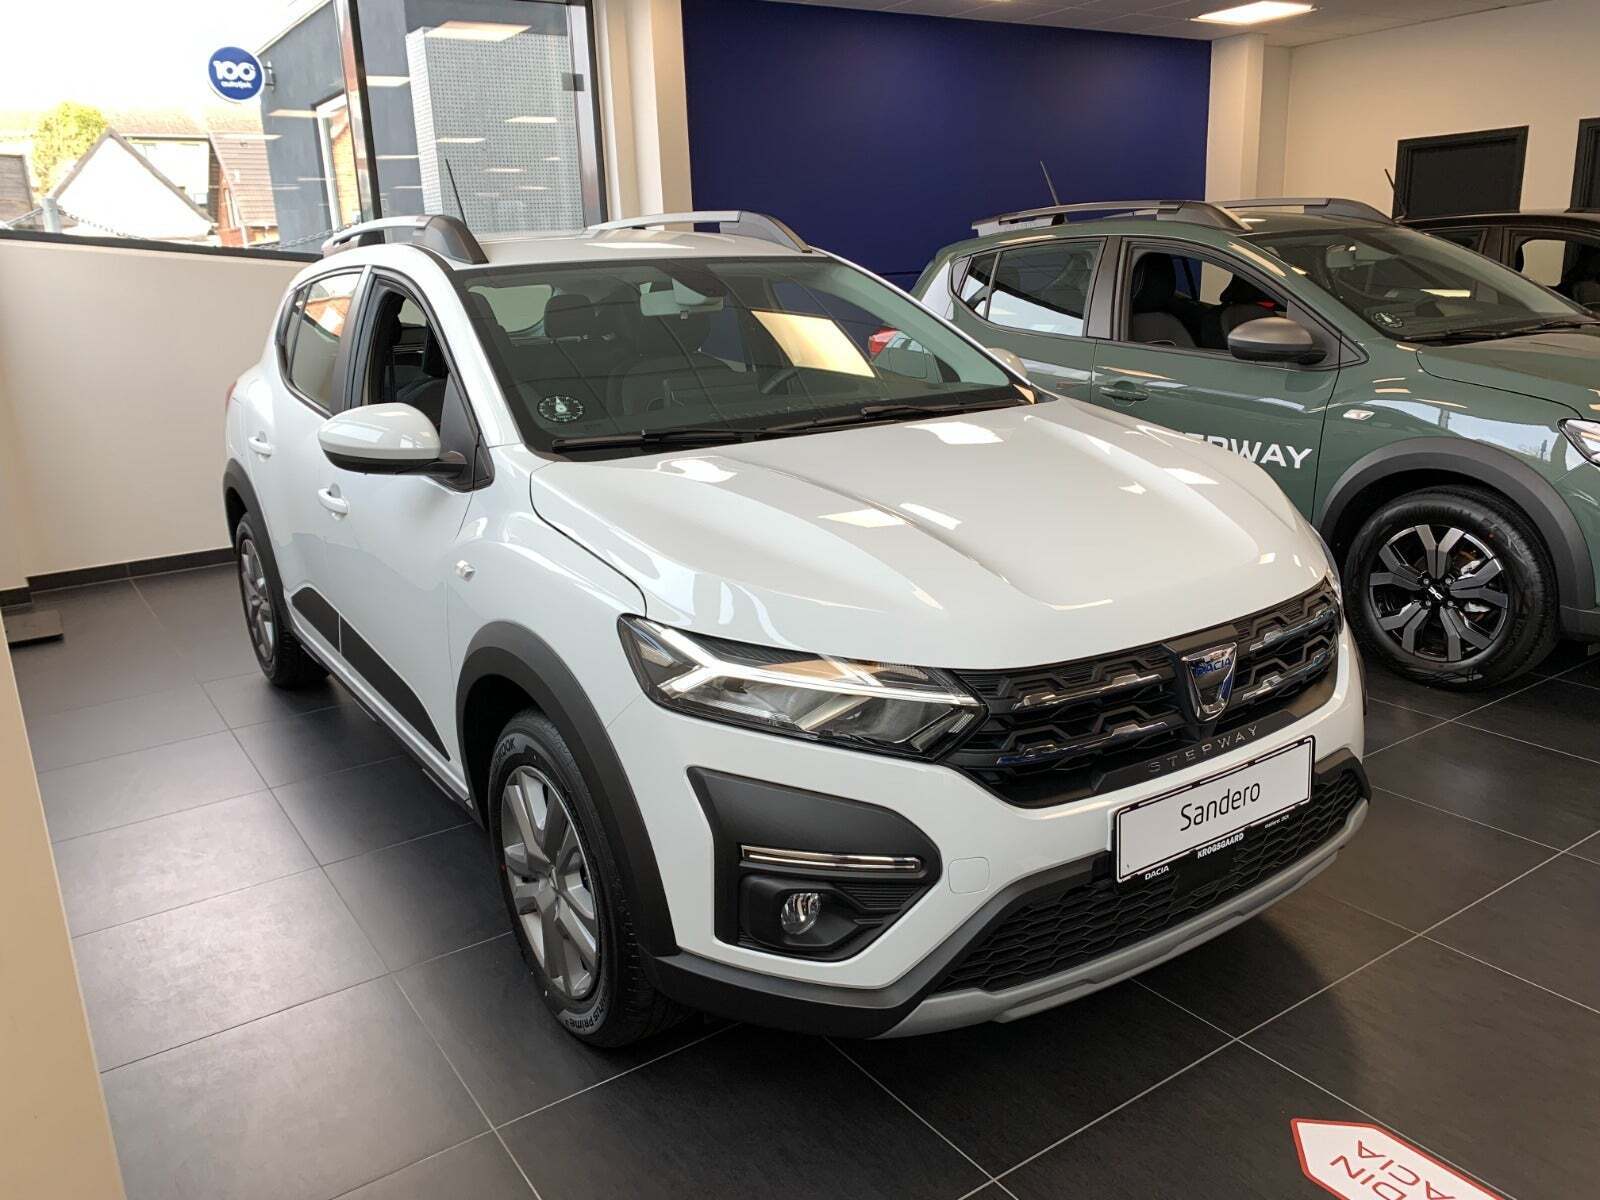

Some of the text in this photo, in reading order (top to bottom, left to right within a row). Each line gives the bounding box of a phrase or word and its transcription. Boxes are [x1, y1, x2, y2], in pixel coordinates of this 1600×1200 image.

[1148, 725, 1257, 773] STEPWAY
[1180, 783, 1260, 831] Sandero
[1144, 865, 1169, 880] DACIA
[1329, 1155, 1407, 1200] DIN
